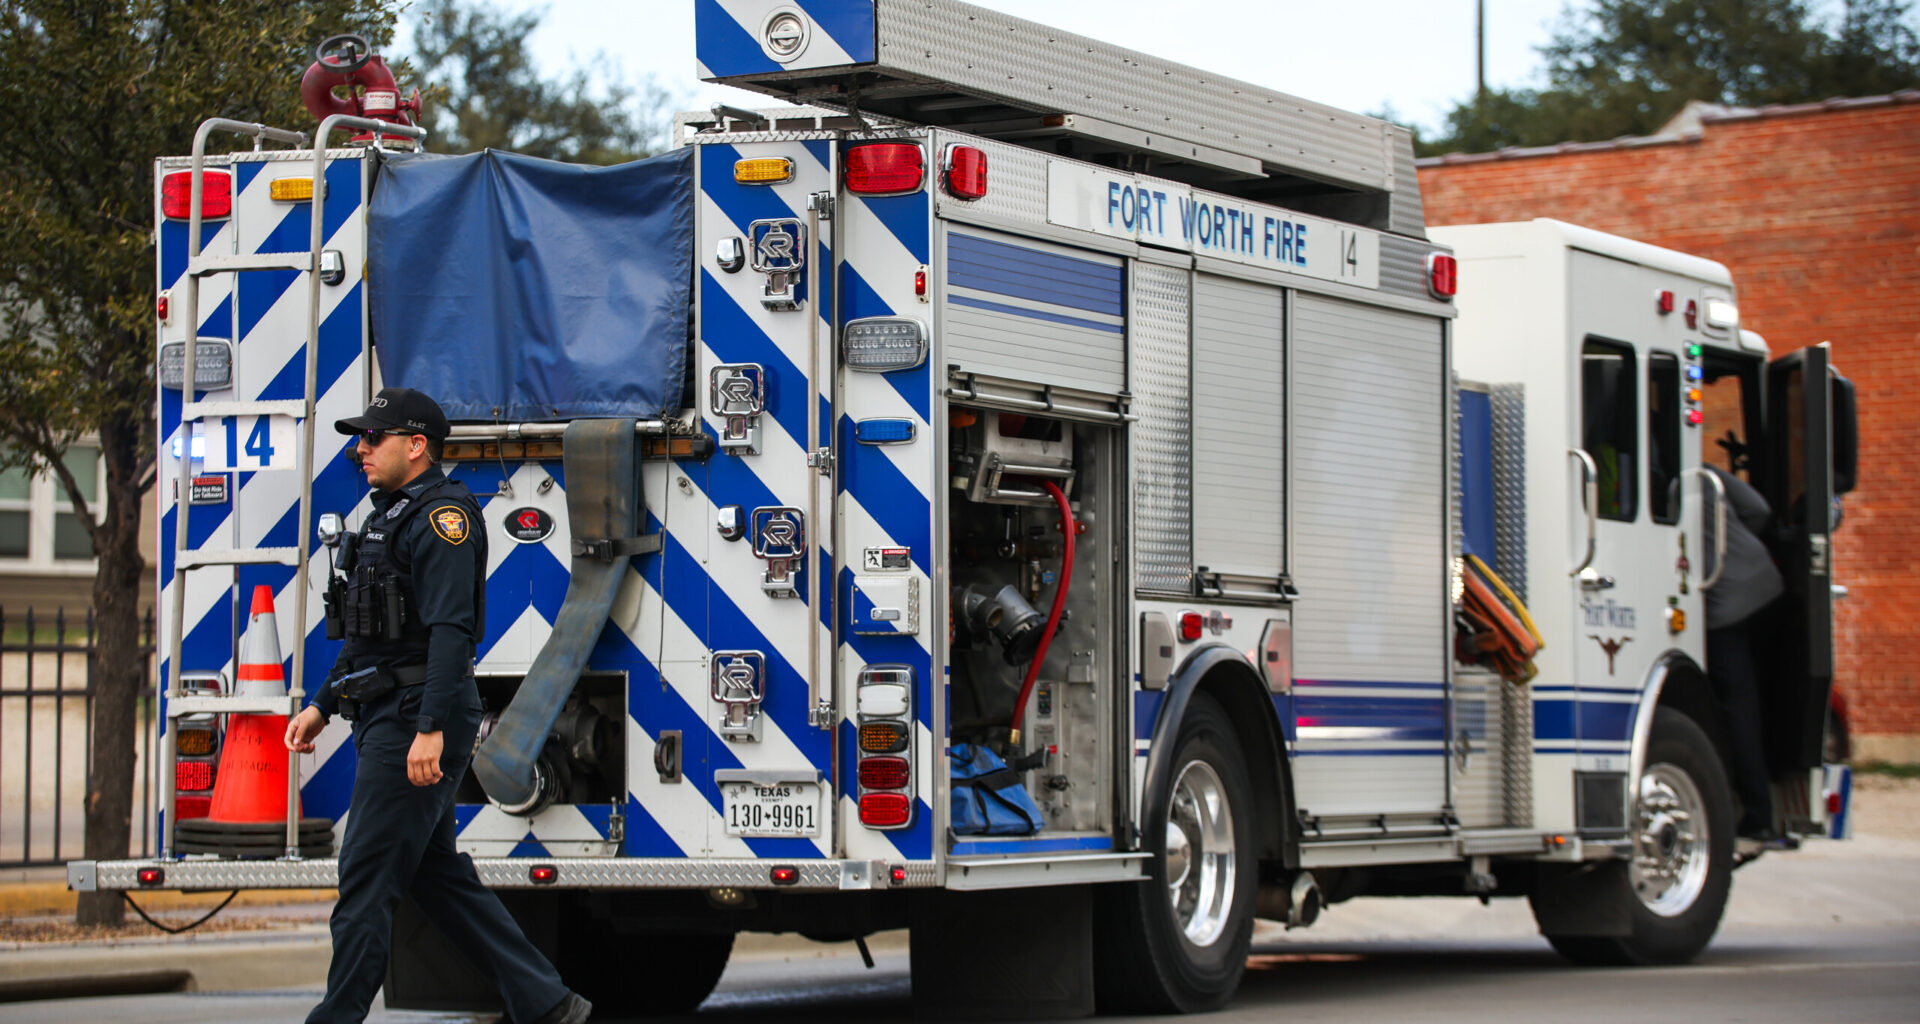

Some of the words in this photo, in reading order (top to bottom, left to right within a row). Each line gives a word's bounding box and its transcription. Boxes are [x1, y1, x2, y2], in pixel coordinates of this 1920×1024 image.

[1108, 181, 1167, 238] FORT
[1179, 196, 1254, 257] WORTH
[1264, 216, 1308, 268] FIRE
[1340, 230, 1358, 277] 14
[221, 414, 275, 468] 14
[366, 533, 385, 541] POLICE
[753, 787, 791, 798] TEXAS
